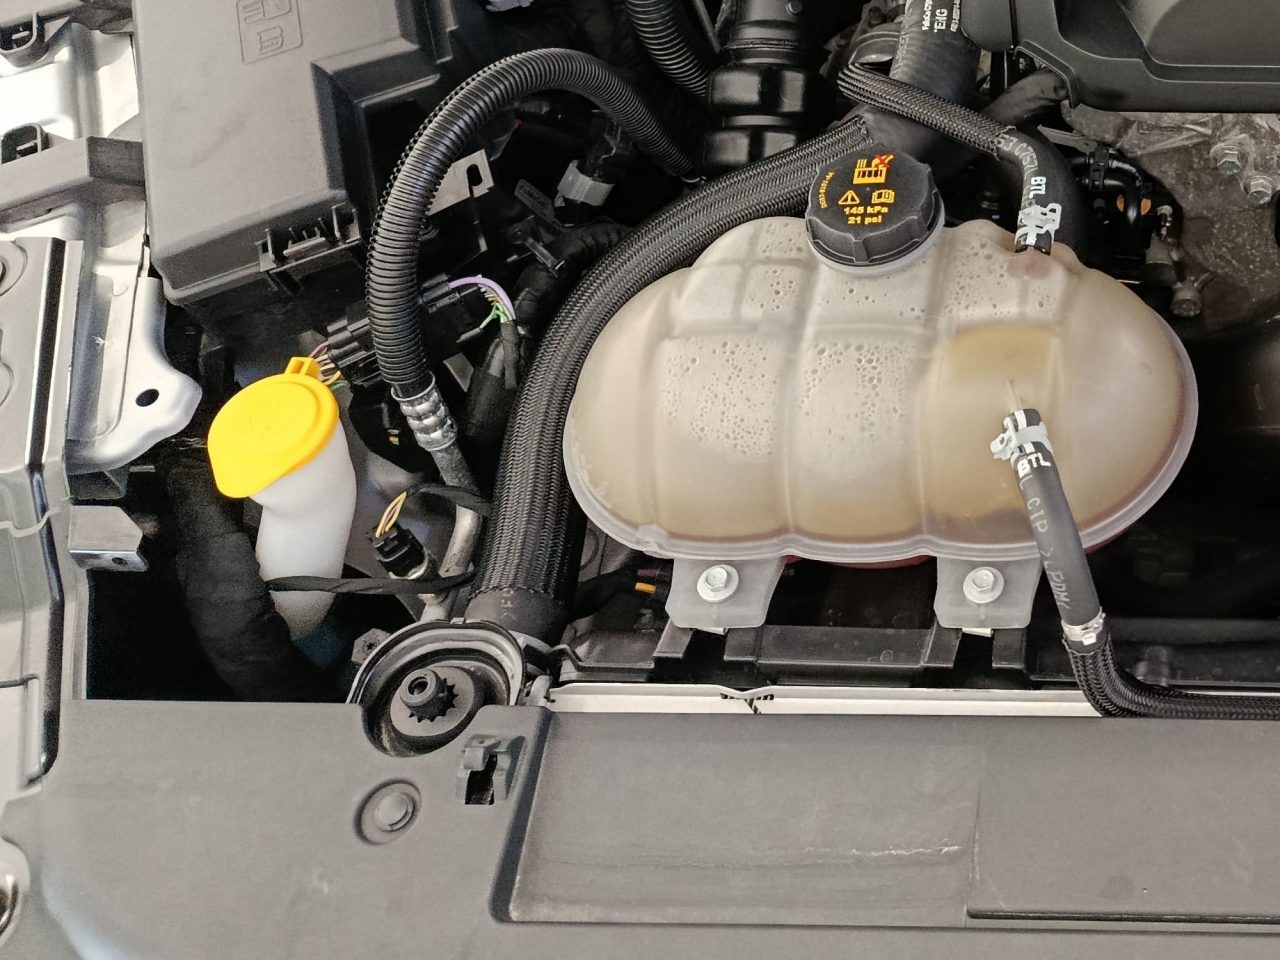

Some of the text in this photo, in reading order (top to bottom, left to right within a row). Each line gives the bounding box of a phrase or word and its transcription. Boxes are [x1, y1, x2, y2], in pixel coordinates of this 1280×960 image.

[1029, 176, 1048, 200] BTL
[843, 205, 888, 215] 145 kPa
[847, 215, 883, 225] 21 psi
[1016, 453, 1051, 478] BTL
